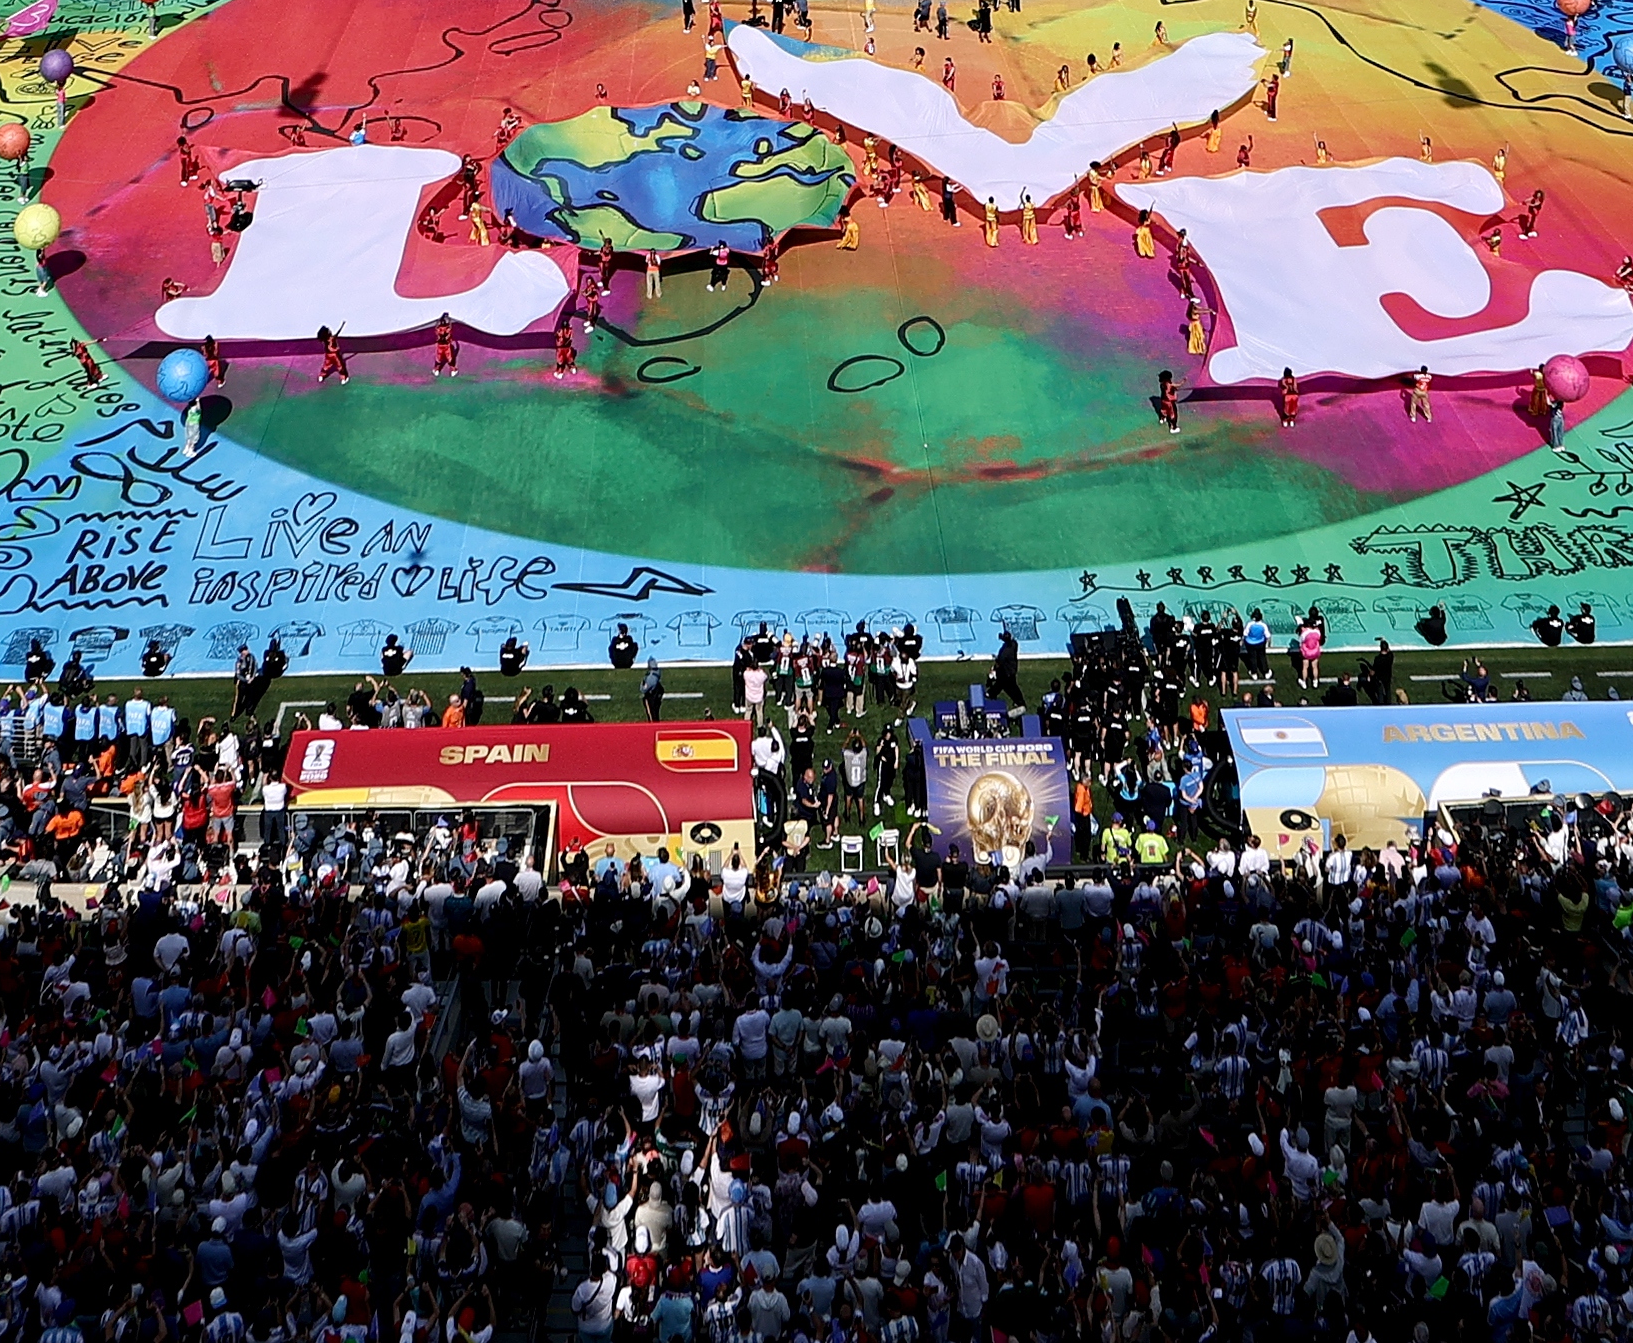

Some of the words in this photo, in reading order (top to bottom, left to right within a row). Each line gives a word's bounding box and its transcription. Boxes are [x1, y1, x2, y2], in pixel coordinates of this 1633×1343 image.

[1382, 720, 1587, 744] ARGENTINA
[439, 743, 551, 766] SPAIN
[933, 746, 955, 755] FIFA
[955, 746, 994, 754] WORLD
[996, 745, 1016, 753] CUP
[1017, 744, 1054, 752] 2026
[934, 754, 982, 768] THE
[984, 752, 1056, 767] FINAL
